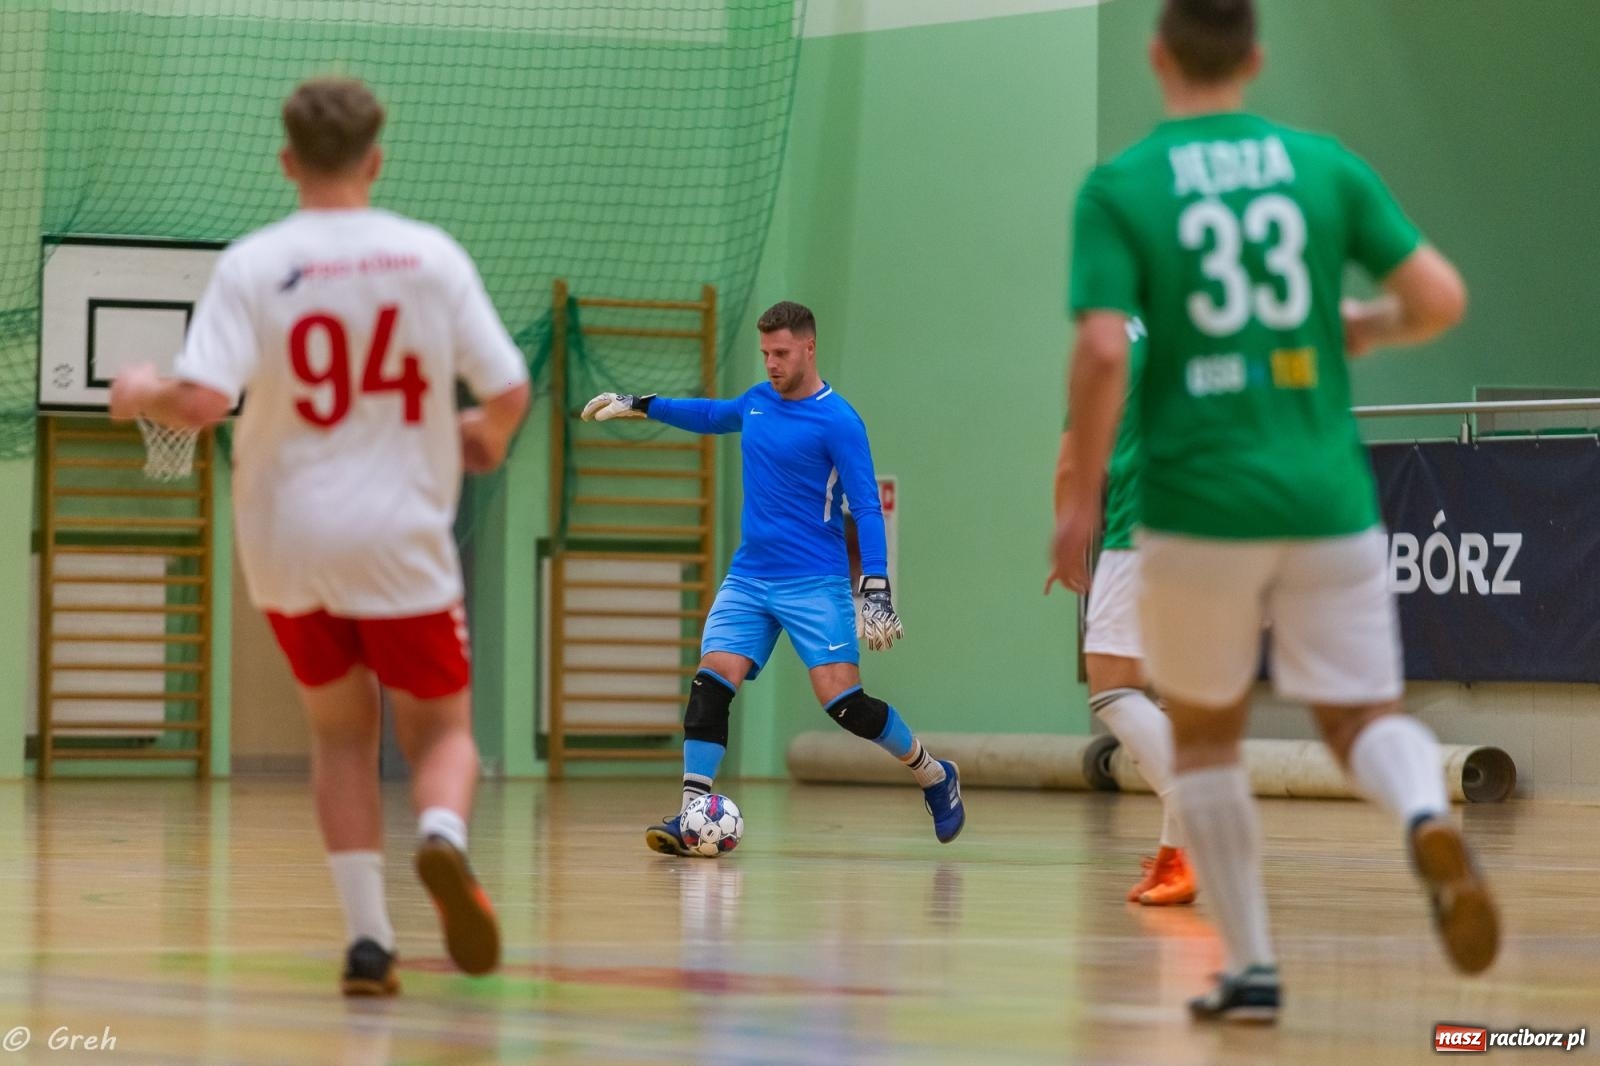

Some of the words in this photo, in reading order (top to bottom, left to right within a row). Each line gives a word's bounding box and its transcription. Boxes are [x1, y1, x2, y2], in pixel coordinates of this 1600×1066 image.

[1178, 194, 1312, 337] 33
[289, 305, 429, 429] 94
[1389, 509, 1523, 595] BÓRZ
